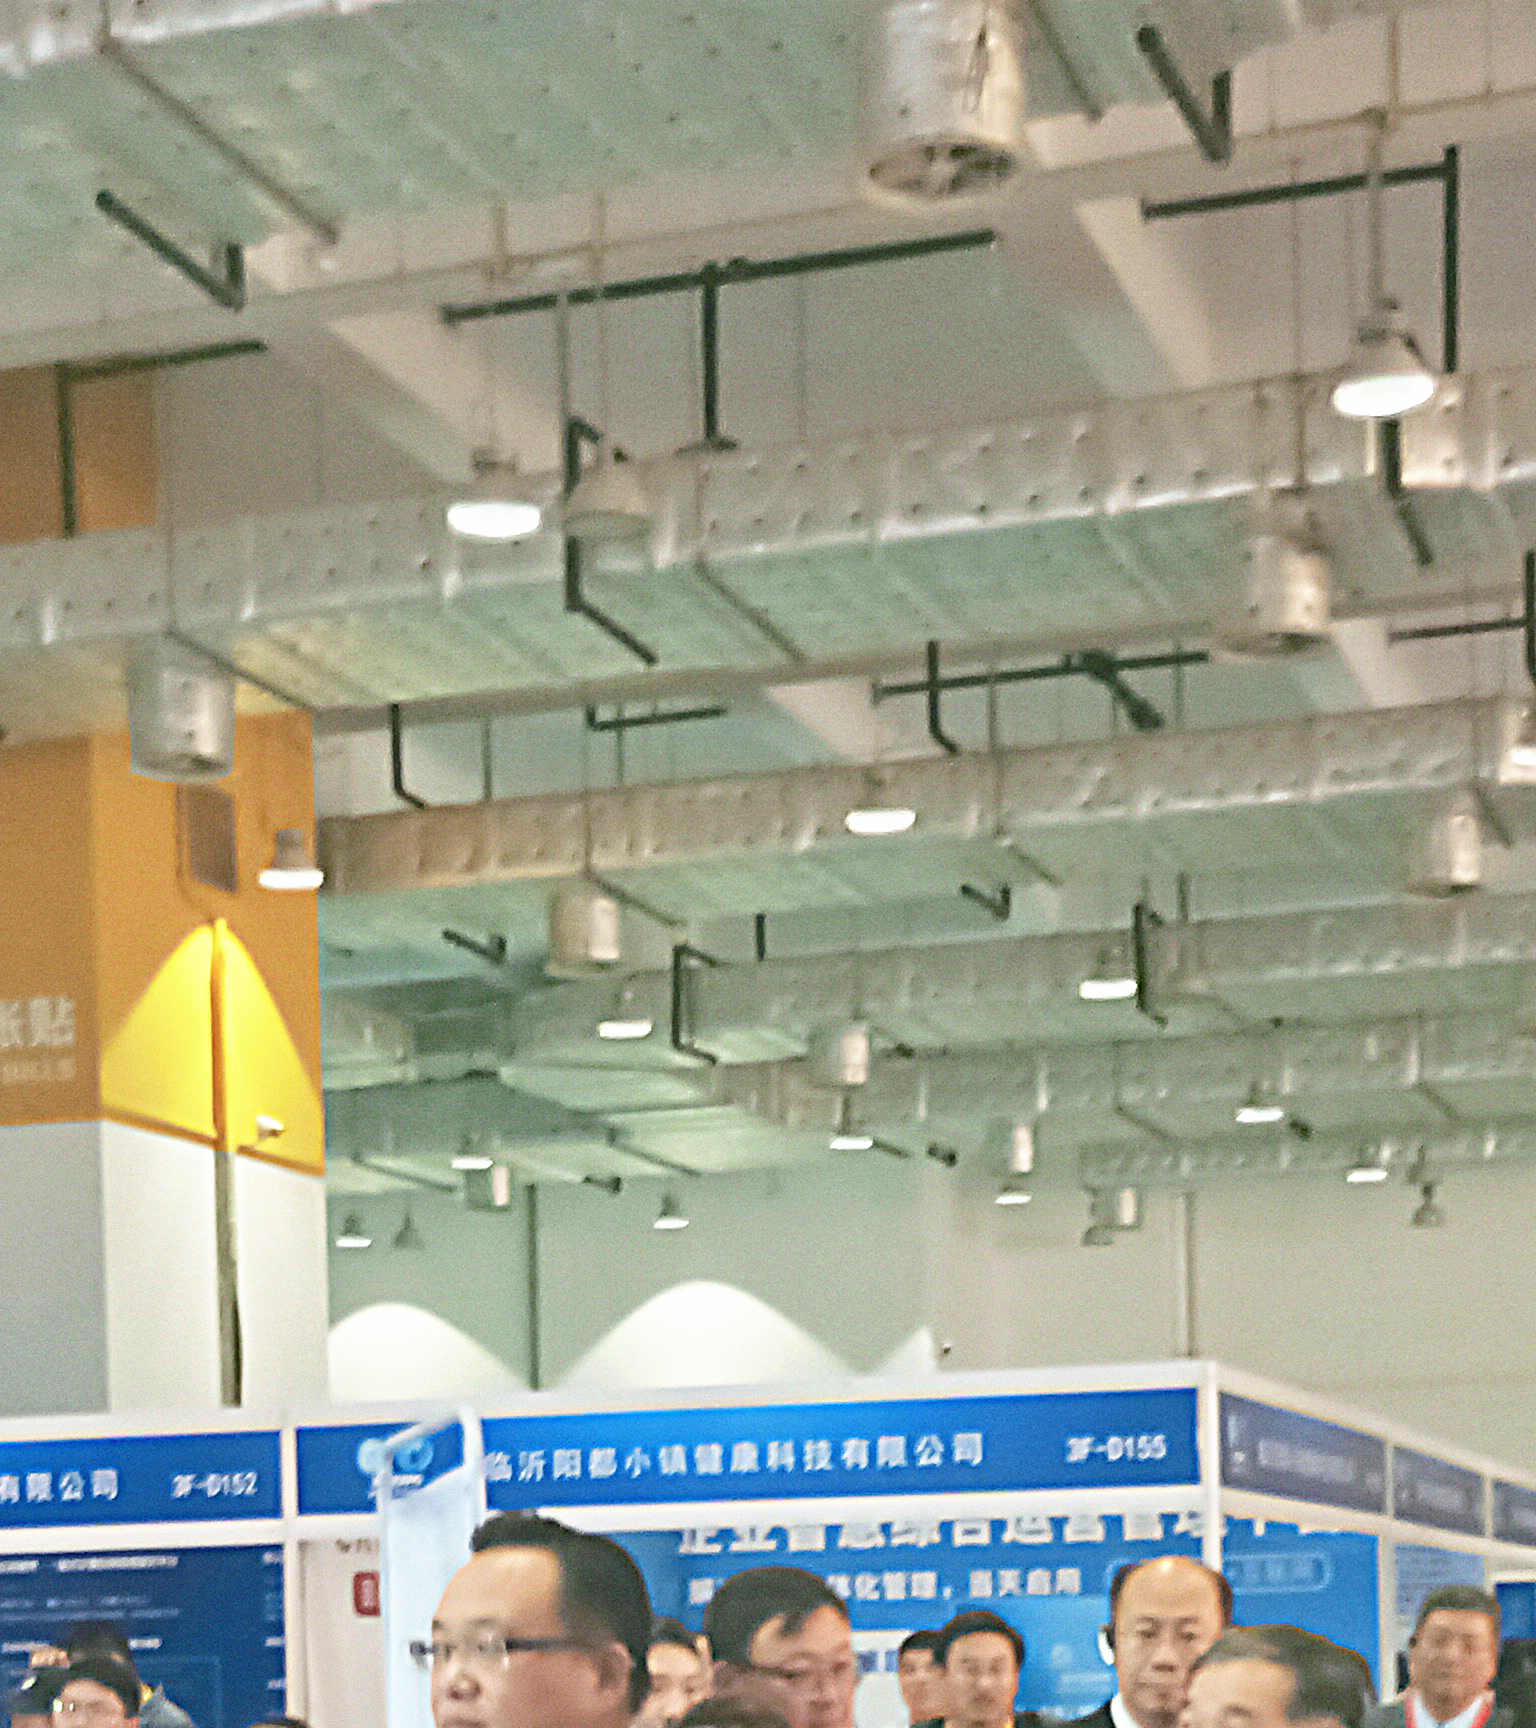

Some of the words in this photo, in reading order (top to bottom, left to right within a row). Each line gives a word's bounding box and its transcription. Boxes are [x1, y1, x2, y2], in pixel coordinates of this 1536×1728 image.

[485, 1431, 984, 1483] 临沂阳都小镇健康科技有限公司
